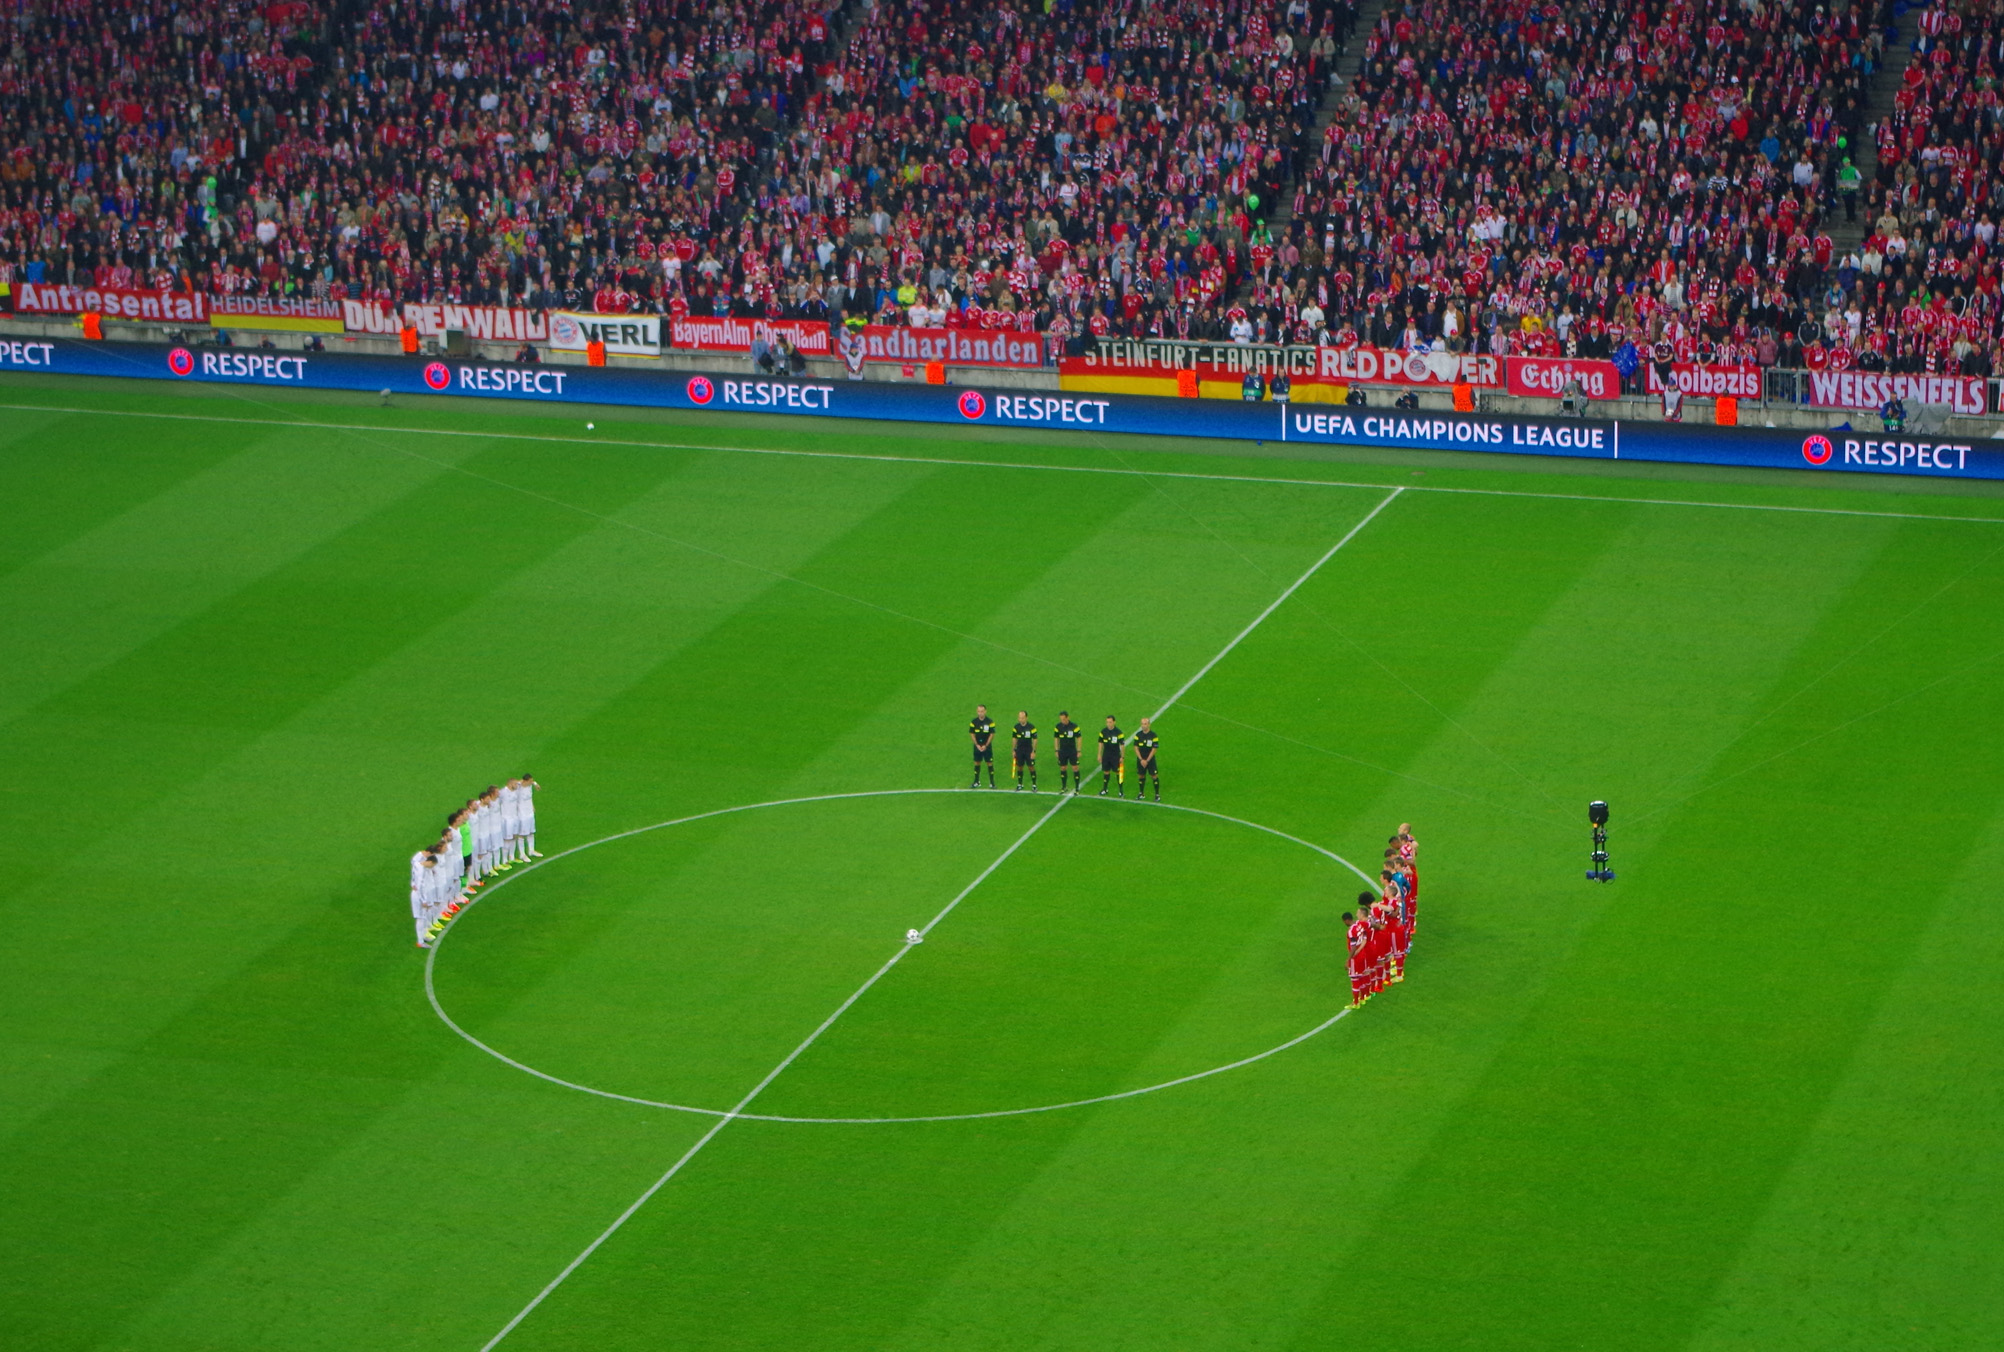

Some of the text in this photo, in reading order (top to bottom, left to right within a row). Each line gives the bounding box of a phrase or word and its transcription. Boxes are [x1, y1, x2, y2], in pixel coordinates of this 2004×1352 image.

[18, 283, 204, 320] Antiesental
[210, 295, 341, 318] HEIDELSHEIM
[578, 321, 658, 347] VERL
[673, 320, 751, 349] BayernAlm
[838, 325, 1039, 364] Sandharlanden
[203, 352, 308, 379] RESPECT
[1084, 341, 1316, 376] STEINFURT-FANATICS
[1321, 348, 1378, 379] RED
[459, 366, 567, 394] RESPECT
[1520, 362, 1605, 396] Eching
[1811, 371, 1985, 415] WEISSENFELS
[723, 381, 834, 409] RESPECT
[996, 396, 1110, 424] RESPECT
[1295, 413, 1604, 449] UEFA CHAMPIONS LEAGUE
[1844, 439, 1972, 469] RESPECT
